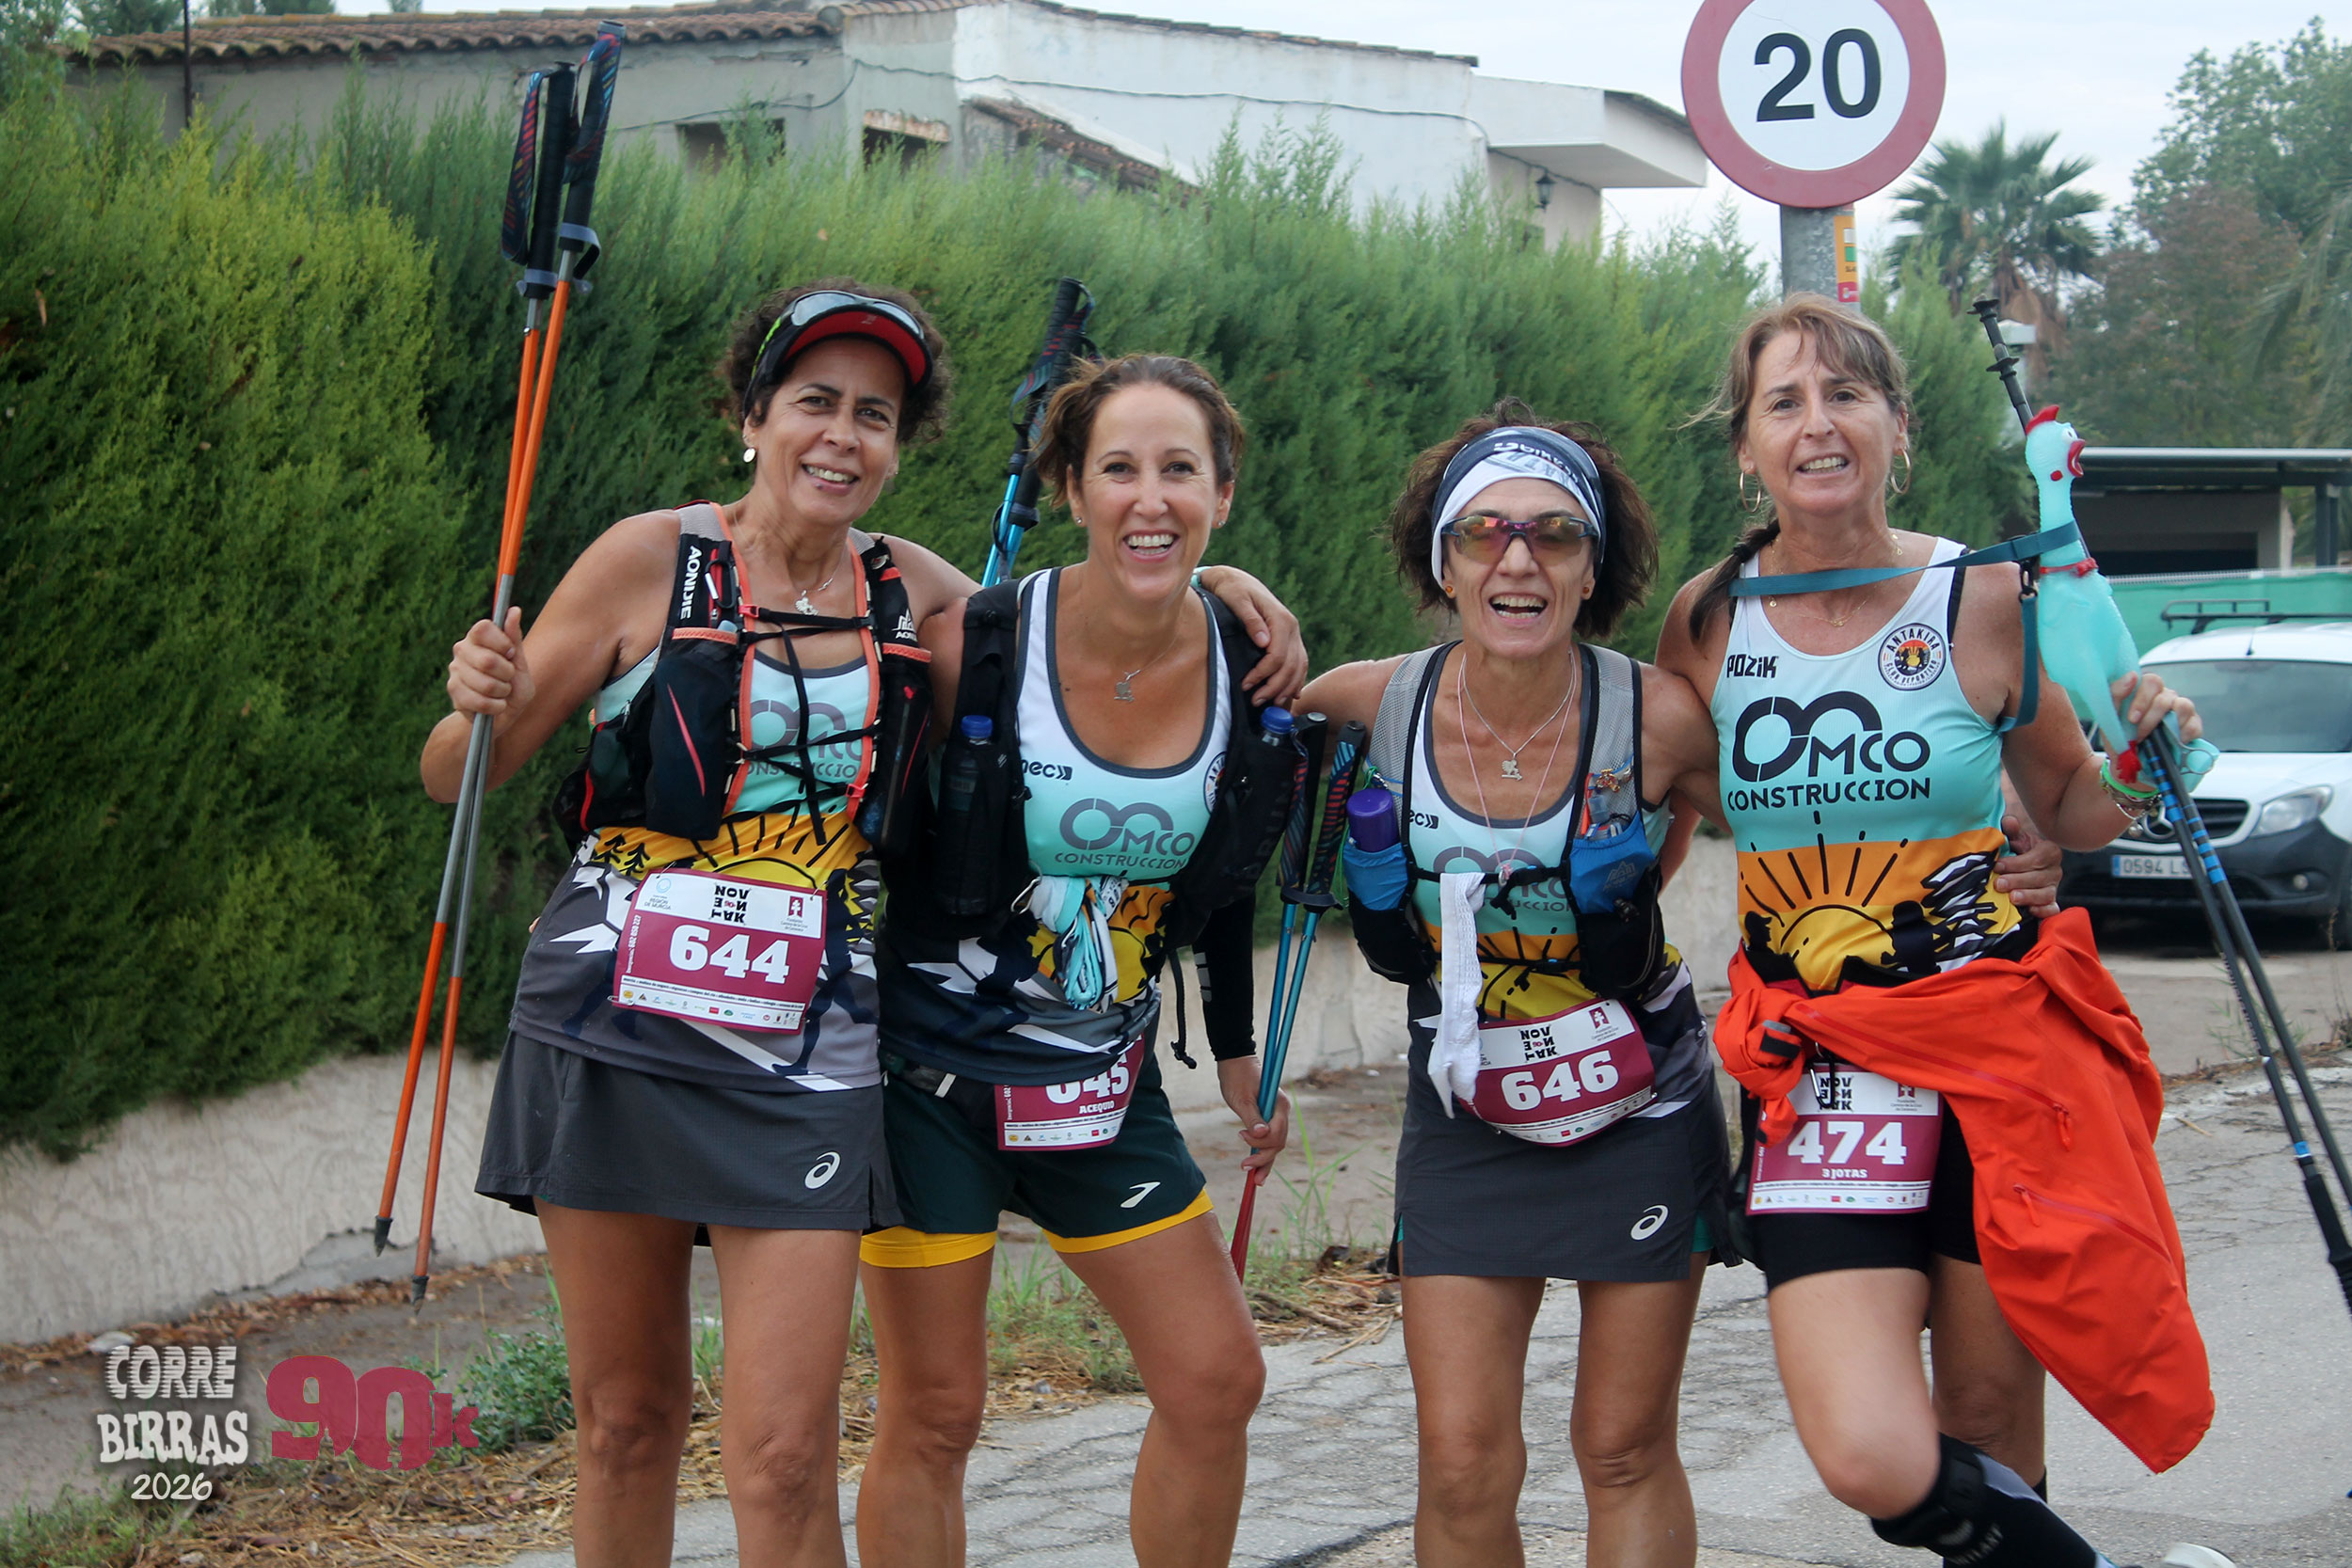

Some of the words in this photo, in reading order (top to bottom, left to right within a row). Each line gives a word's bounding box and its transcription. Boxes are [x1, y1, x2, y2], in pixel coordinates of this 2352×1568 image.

[1755, 28, 1882, 122] 20
[1886, 628, 1940, 653] ANTAKIRA
[1727, 777, 1931, 811] CONSTRUCCION
[1055, 852, 1186, 869] CONSTRUCCION
[2123, 858, 2163, 874] 0594
[2170, 859, 2190, 875] LS
[715, 885, 750, 899] NOV
[669, 925, 790, 984] 644
[1520, 1026, 1551, 1040] NOV
[1501, 1050, 1619, 1111] 646
[1079, 1101, 1115, 1114] ACEQUIO
[1788, 1120, 1907, 1165] 474
